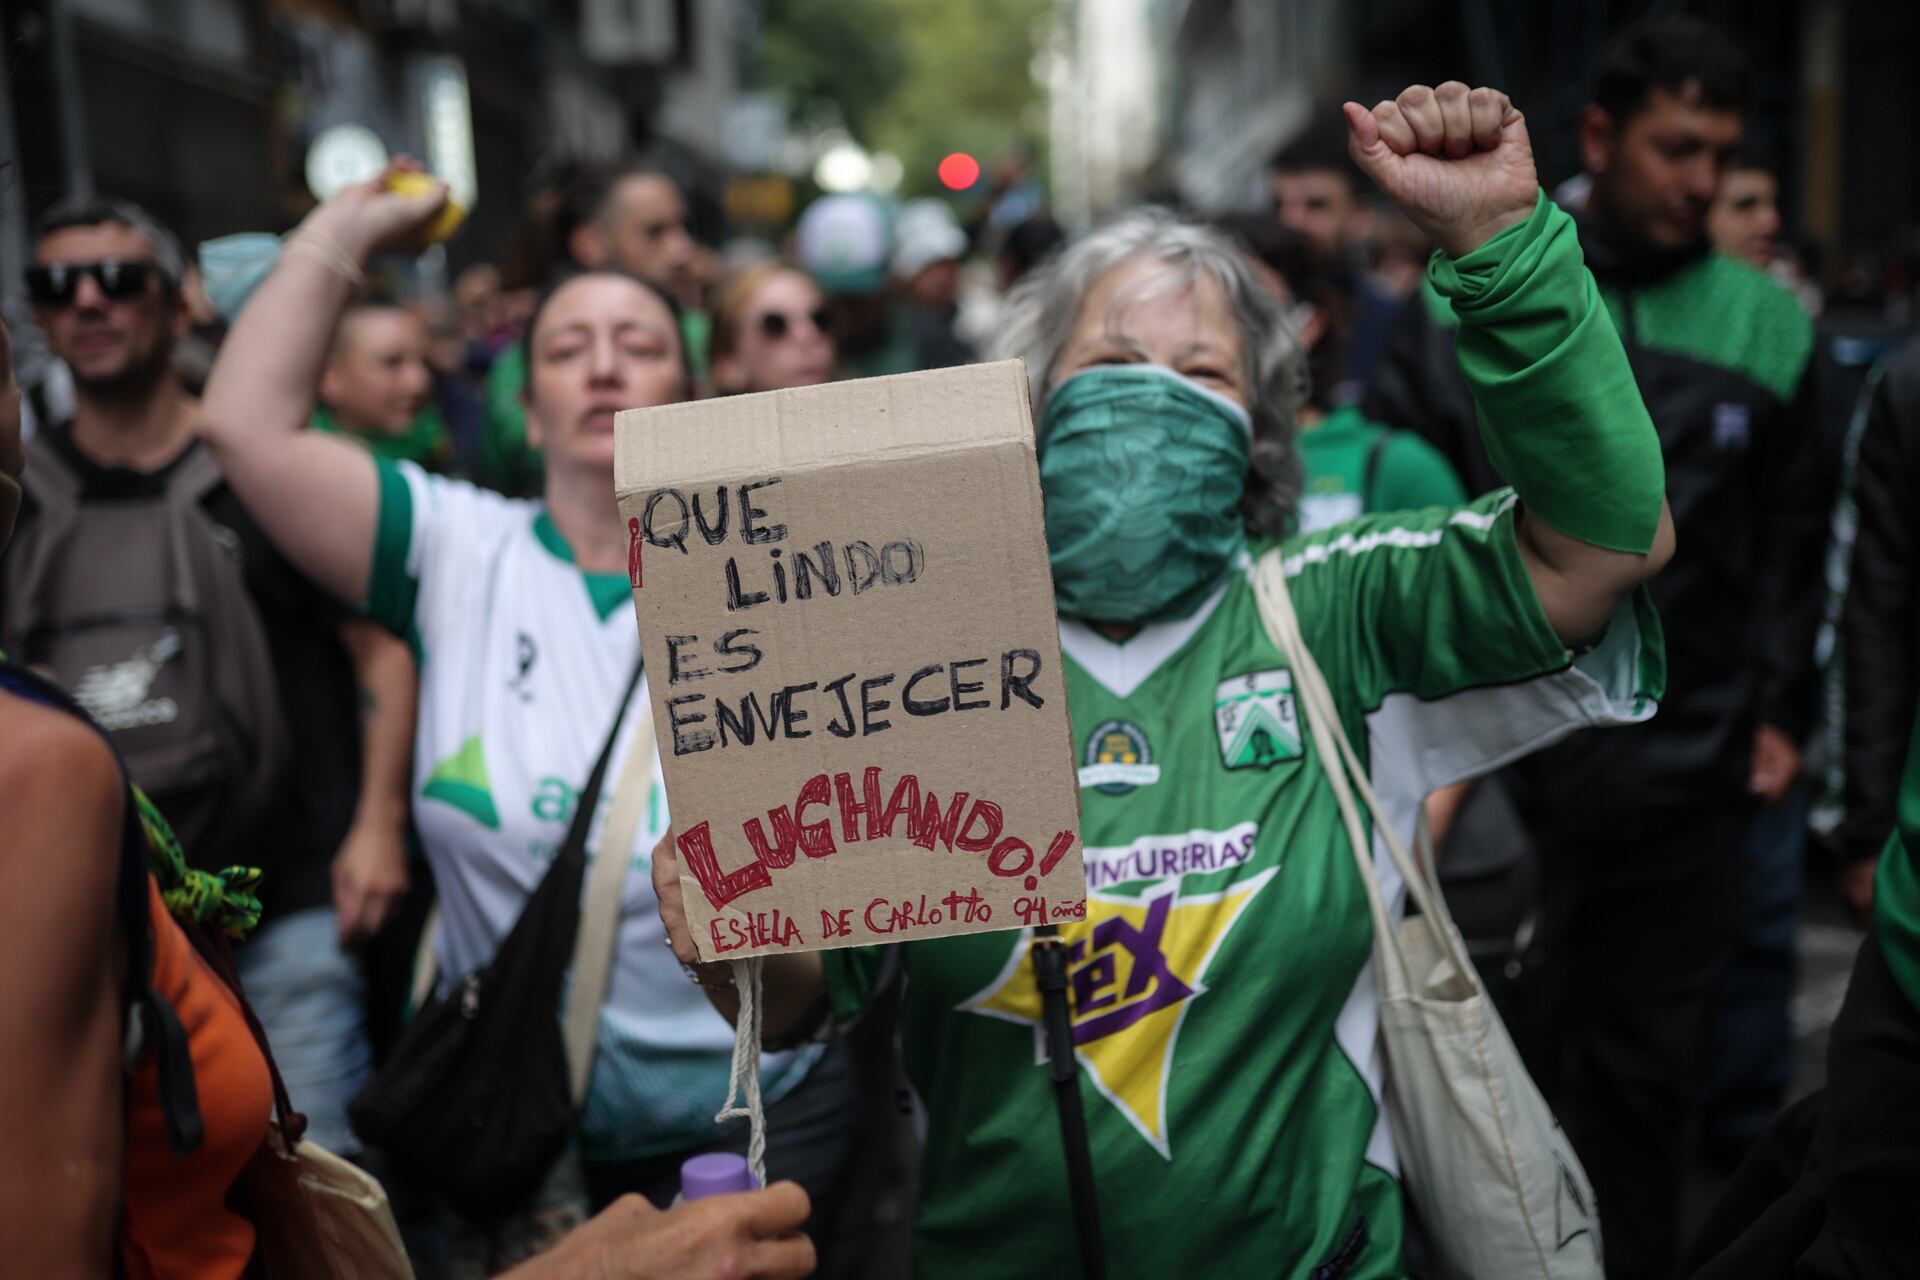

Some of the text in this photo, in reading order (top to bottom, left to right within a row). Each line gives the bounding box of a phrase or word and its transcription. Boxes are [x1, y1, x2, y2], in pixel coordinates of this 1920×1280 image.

[665, 628, 763, 685] ES
[667, 648, 1045, 757] ENVEJECER
[677, 767, 1075, 911] LUCHANDO!
[821, 909, 854, 939] DE
[1014, 896, 1048, 925] 94
